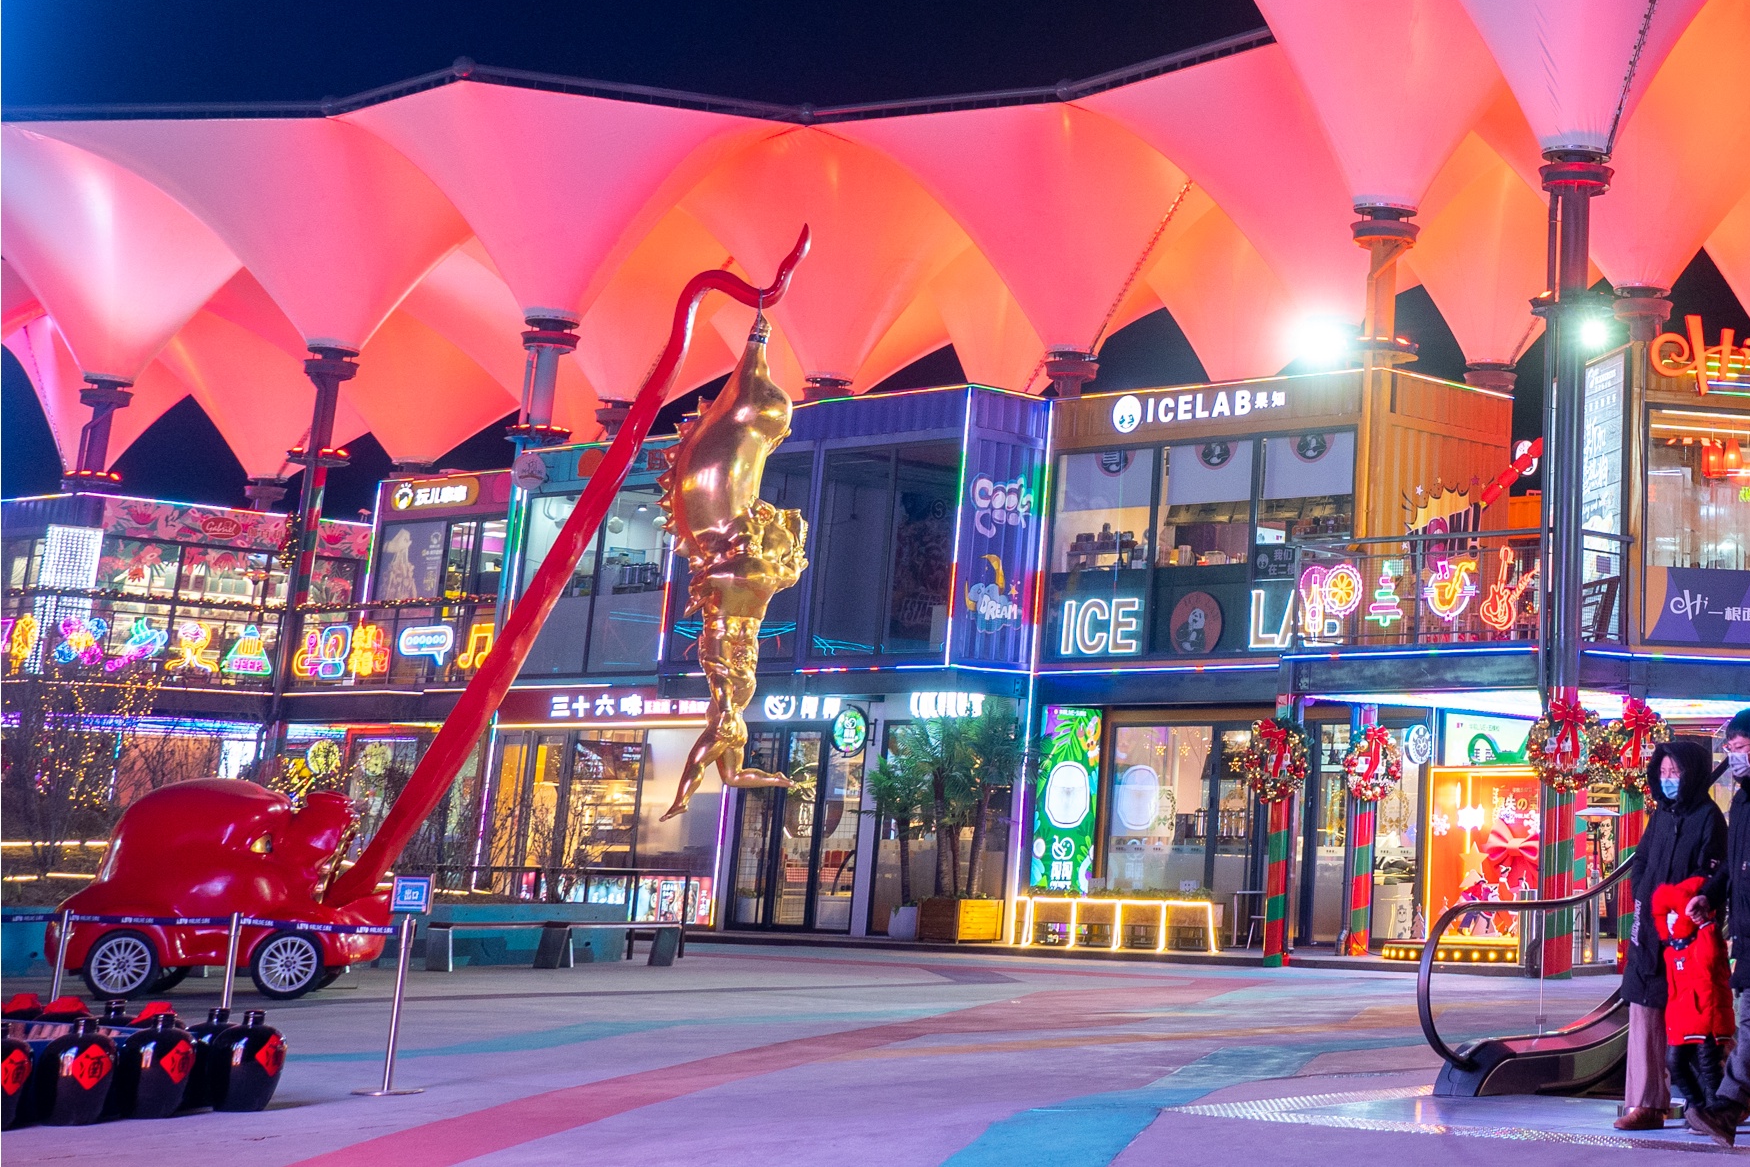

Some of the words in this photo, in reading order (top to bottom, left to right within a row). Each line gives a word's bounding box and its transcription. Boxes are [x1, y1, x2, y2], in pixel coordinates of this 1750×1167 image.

[1146, 390, 1252, 423] ICELAB
[1273, 548, 1292, 561] 我们
[979, 594, 1018, 620] DREAM
[1060, 597, 1139, 654] ICE
[232, 658, 263, 671] BEER
[404, 888, 419, 901] 出口
[80, 1054, 107, 1079] 酒
